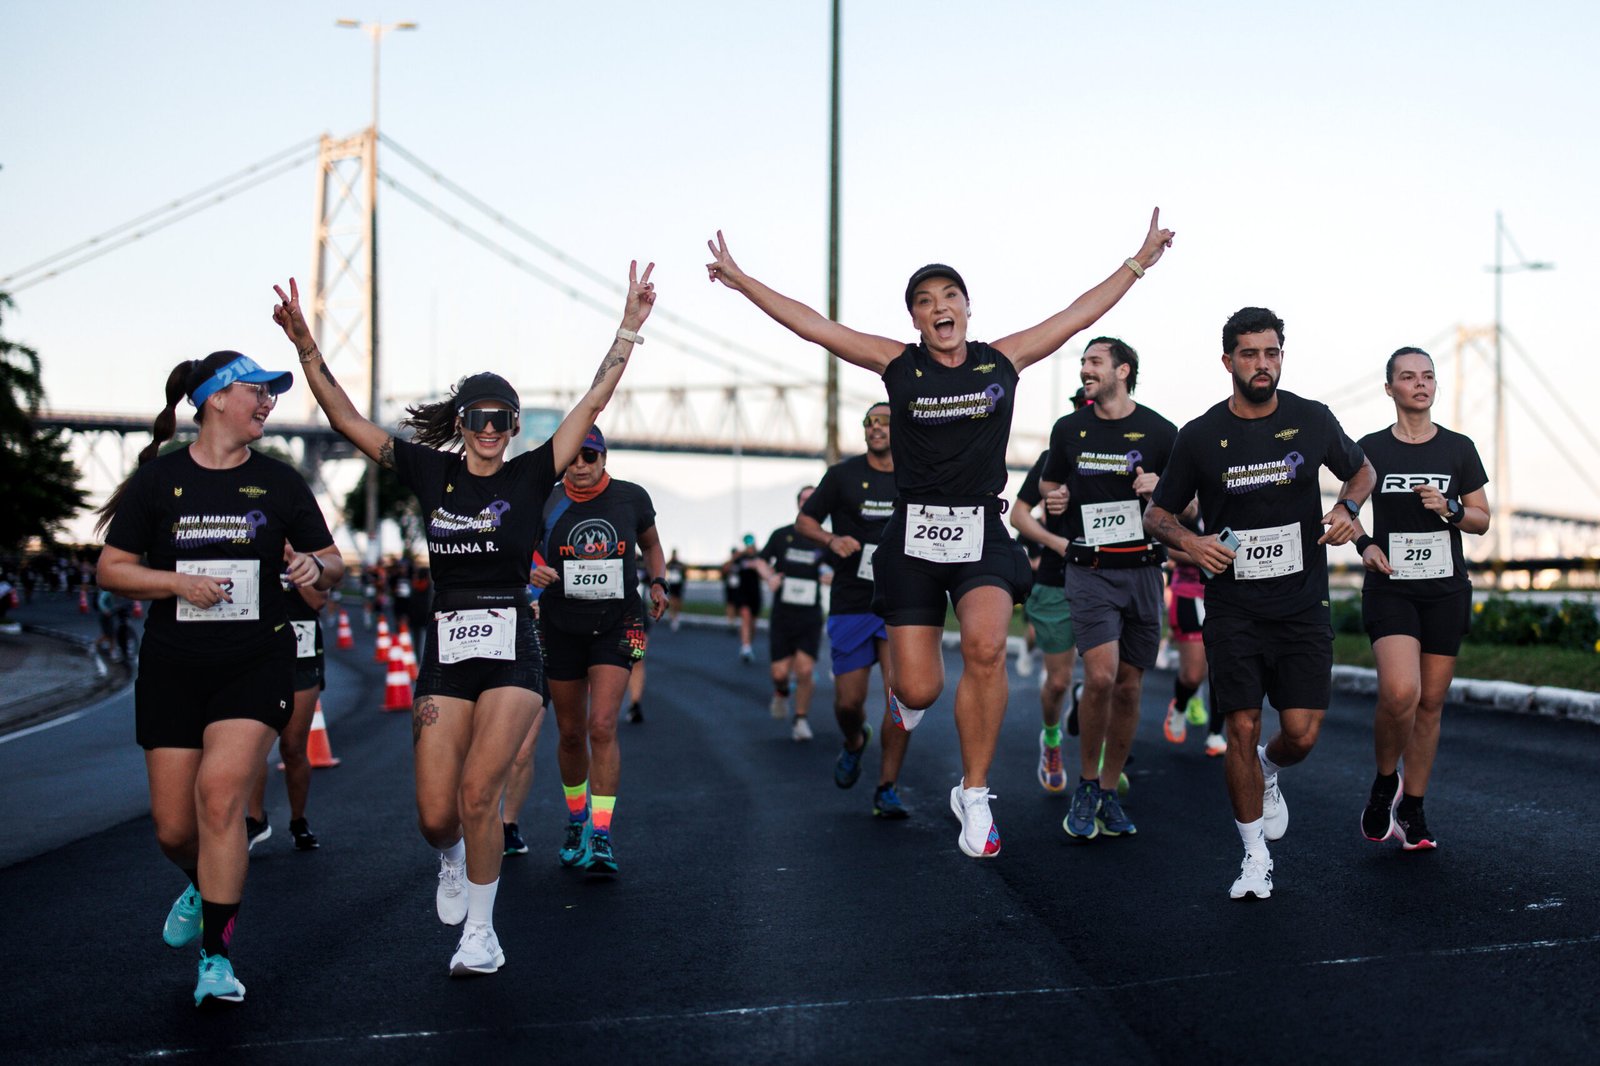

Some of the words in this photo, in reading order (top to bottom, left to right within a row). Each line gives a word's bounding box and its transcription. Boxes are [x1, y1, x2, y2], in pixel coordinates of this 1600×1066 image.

[916, 397, 937, 405] MEIA
[940, 392, 986, 404] MARATONA
[913, 406, 986, 418] FLORIANÓPOLIS
[1228, 465, 1246, 474] MEIA
[1248, 460, 1286, 471] MARATONA
[1227, 472, 1287, 488] FLORIANÓPOLIS
[1386, 477, 1449, 490] RPT
[180, 516, 200, 524] MEIA
[202, 516, 247, 524] MARATONA
[1092, 514, 1125, 529] 2170
[176, 527, 247, 540] FLORIANÓPOLIS
[914, 525, 964, 541] 2602
[486, 541, 499, 553] R.
[1246, 544, 1283, 560] 1018
[1404, 548, 1432, 561] 219
[572, 573, 608, 586] 3610
[449, 624, 493, 642] 1889
